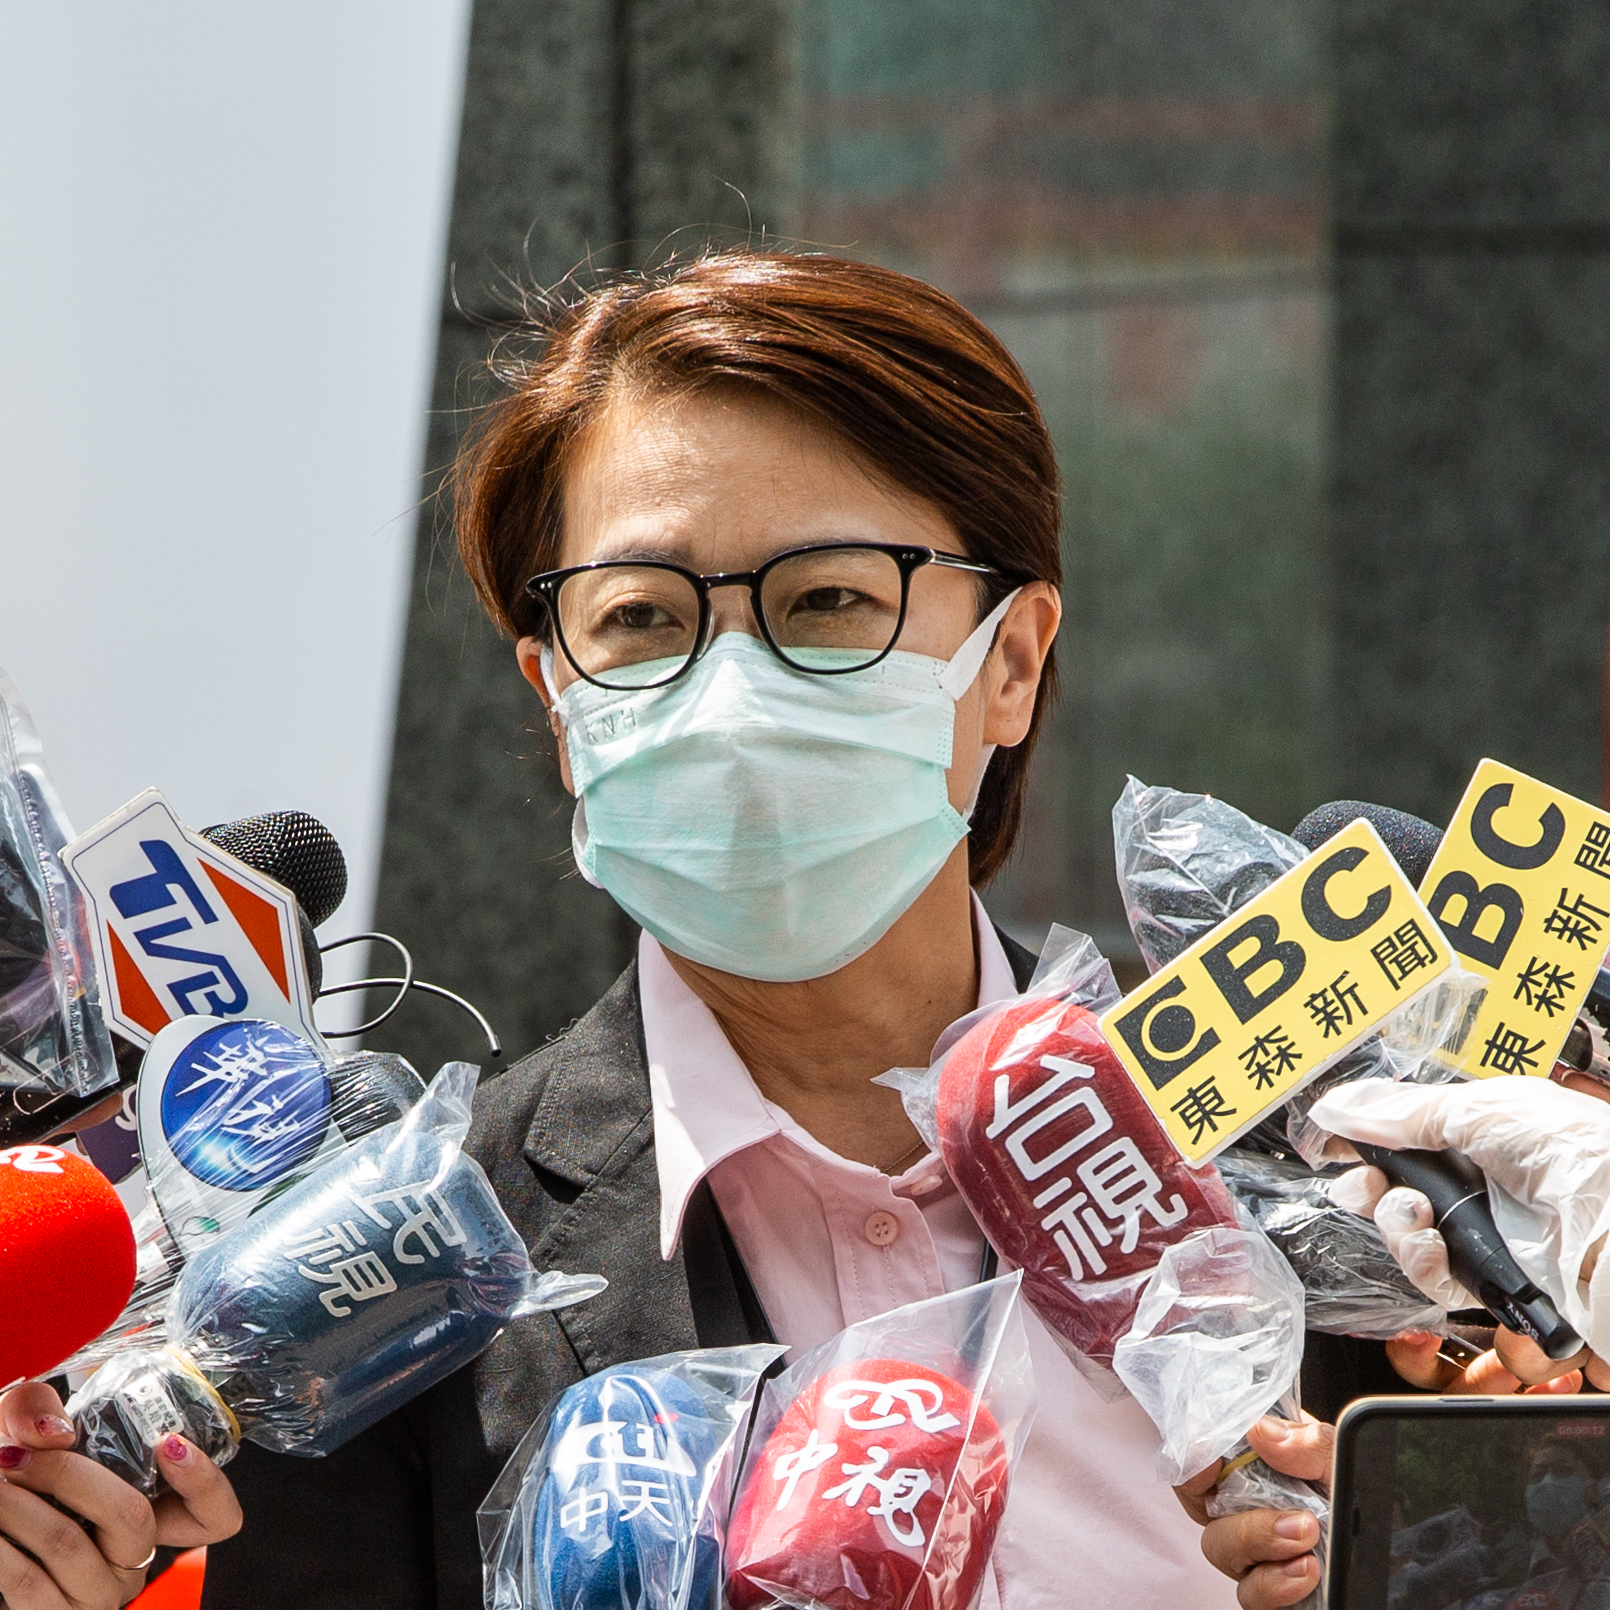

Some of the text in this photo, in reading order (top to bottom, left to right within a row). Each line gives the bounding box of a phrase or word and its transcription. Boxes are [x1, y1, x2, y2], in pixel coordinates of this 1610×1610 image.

[109, 838, 249, 1017] TVB
[1426, 781, 1567, 971] BC
[1170, 918, 1438, 1146] 東森新聞
[284, 1179, 467, 1318] 民視
[986, 1055, 1188, 1281] 台視
[560, 1479, 673, 1532] 中天
[774, 1428, 931, 1547] 中視
